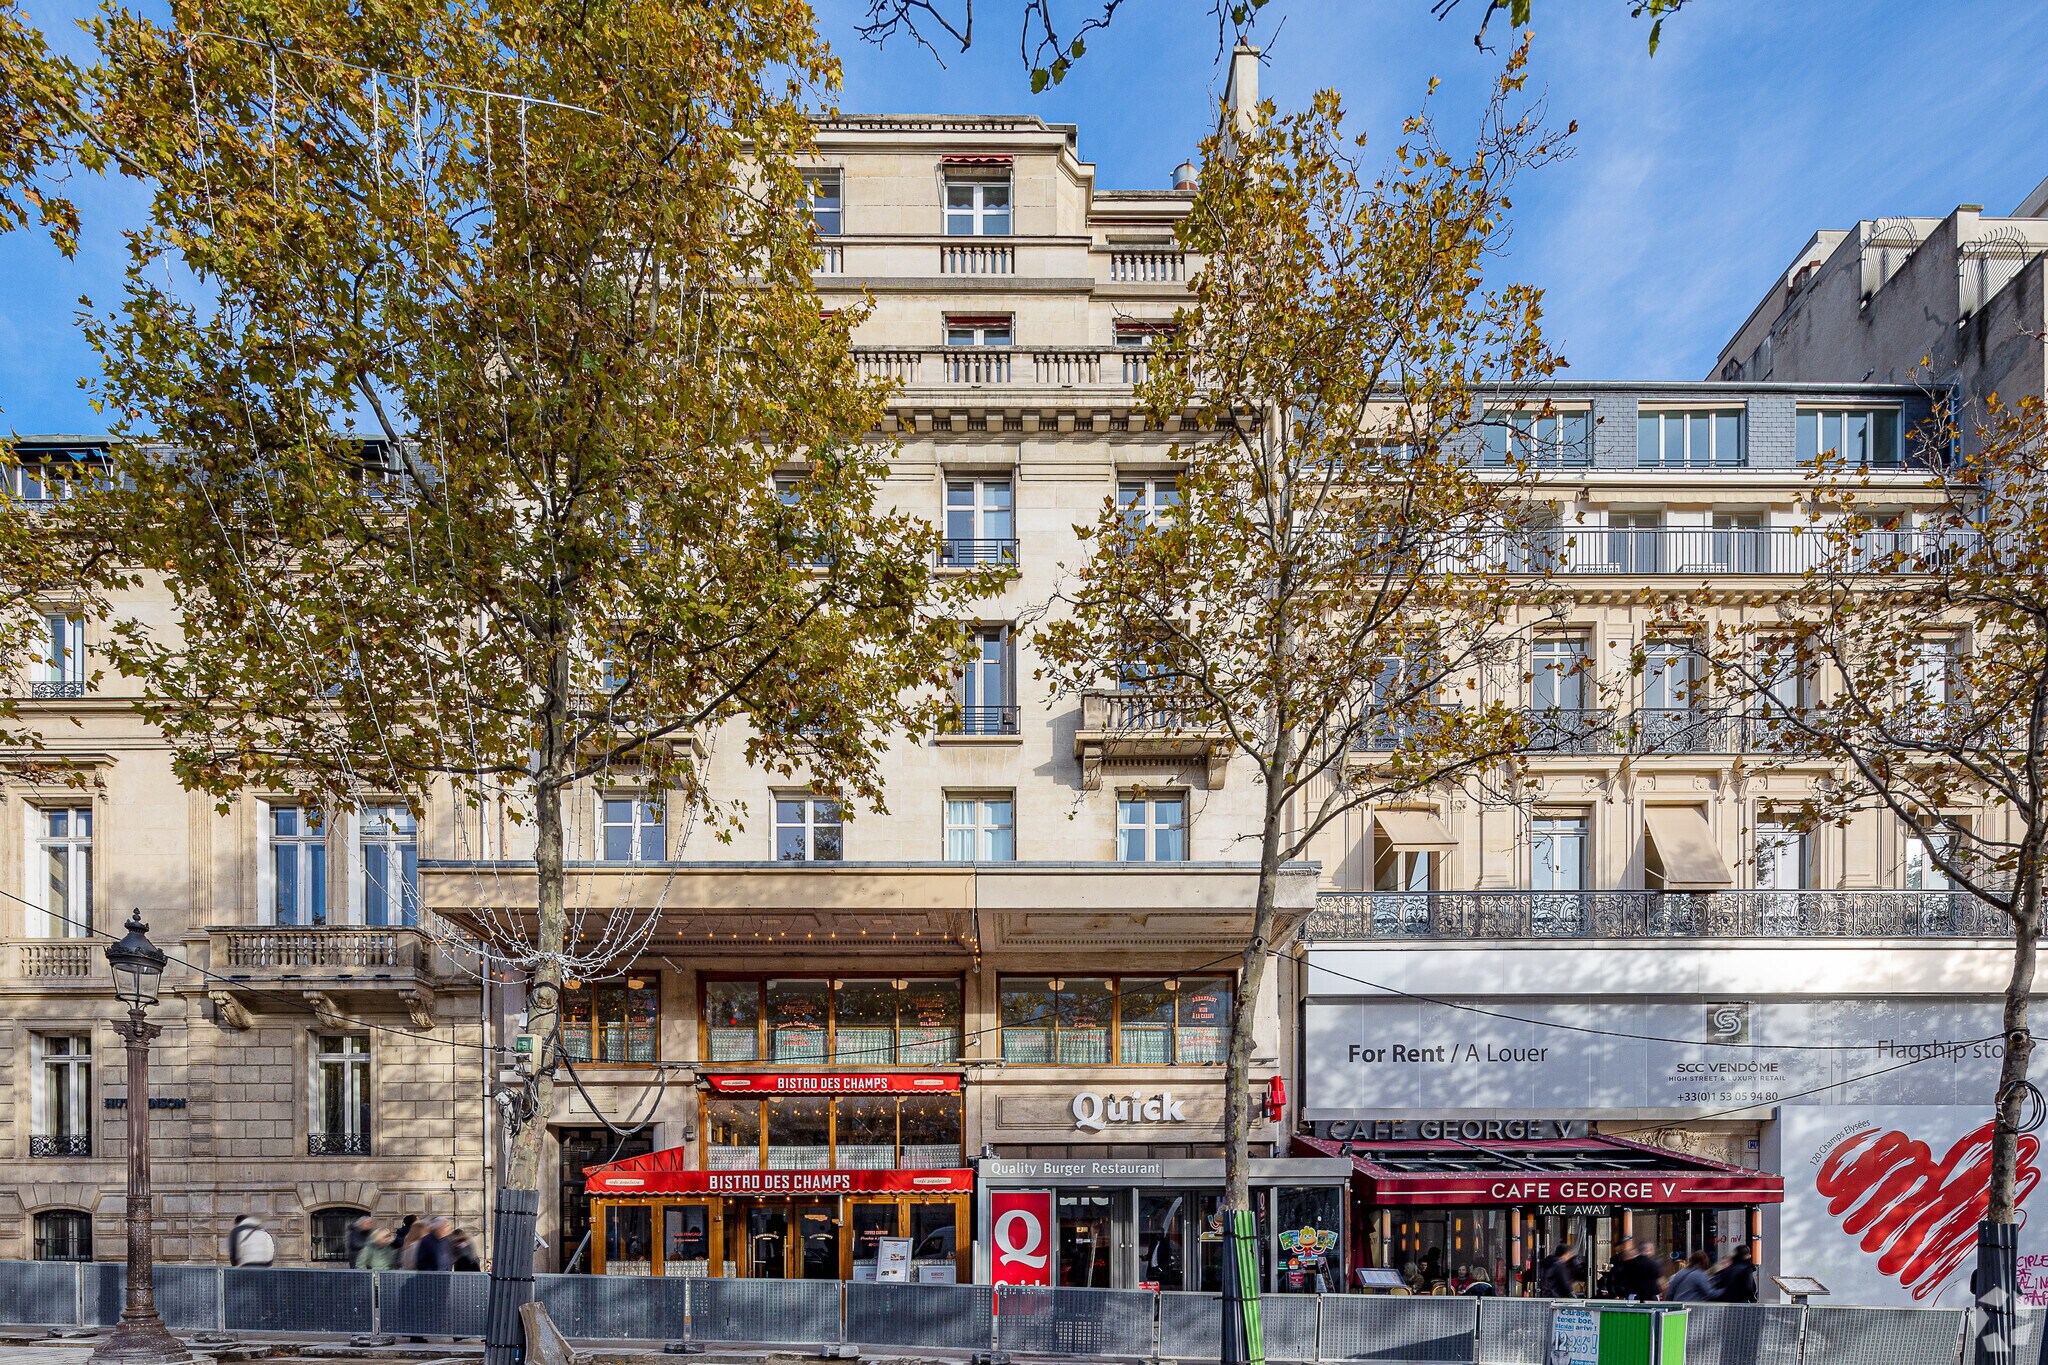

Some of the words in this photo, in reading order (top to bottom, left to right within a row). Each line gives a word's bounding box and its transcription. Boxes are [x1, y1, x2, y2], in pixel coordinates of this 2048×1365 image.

[1348, 1044, 1386, 1063] For
[1392, 1044, 1445, 1063] Rent
[1450, 1043, 1460, 1064] /
[1466, 1045, 1480, 1062] A
[1487, 1044, 1549, 1063] Louer
[1877, 1039, 1967, 1064] Flagship
[1973, 1041, 2004, 1059] sto
[1676, 1063, 1705, 1073] SCC
[1708, 1060, 1779, 1073] VENDÔME
[777, 1077, 818, 1089] BISTRO
[820, 1077, 840, 1089] DES
[844, 1077, 888, 1089] CHAMPS
[105, 1098, 186, 1109] HUTINSON
[1677, 1092, 1716, 1102] +33(0)1
[1720, 1092, 1732, 1101] 53
[1735, 1092, 1748, 1101] 05
[1750, 1092, 1763, 1101] 94
[1765, 1092, 1778, 1101] 80
[1072, 1090, 1186, 1130] Quick
[1420, 1120, 1544, 1140] GEORGE
[1554, 1120, 1575, 1140] V
[1810, 1152, 1822, 1166] 120
[1818, 1132, 1845, 1154] Champs
[1844, 1120, 1871, 1134] Elysées
[991, 1162, 1037, 1176] Quality
[1044, 1162, 1086, 1176] Burger
[1092, 1162, 1160, 1174] Restaurant
[709, 1175, 760, 1190] BISTRO
[764, 1174, 790, 1189] DES
[793, 1174, 850, 1189] CHAMPS
[1492, 1182, 1550, 1198] CAFE
[1560, 1182, 1653, 1198] GEORGE
[1662, 1183, 1676, 1198] V
[1538, 1205, 1566, 1215] TAKE
[1574, 1205, 1608, 1215] AWAY
[994, 1209, 1048, 1269] Q
